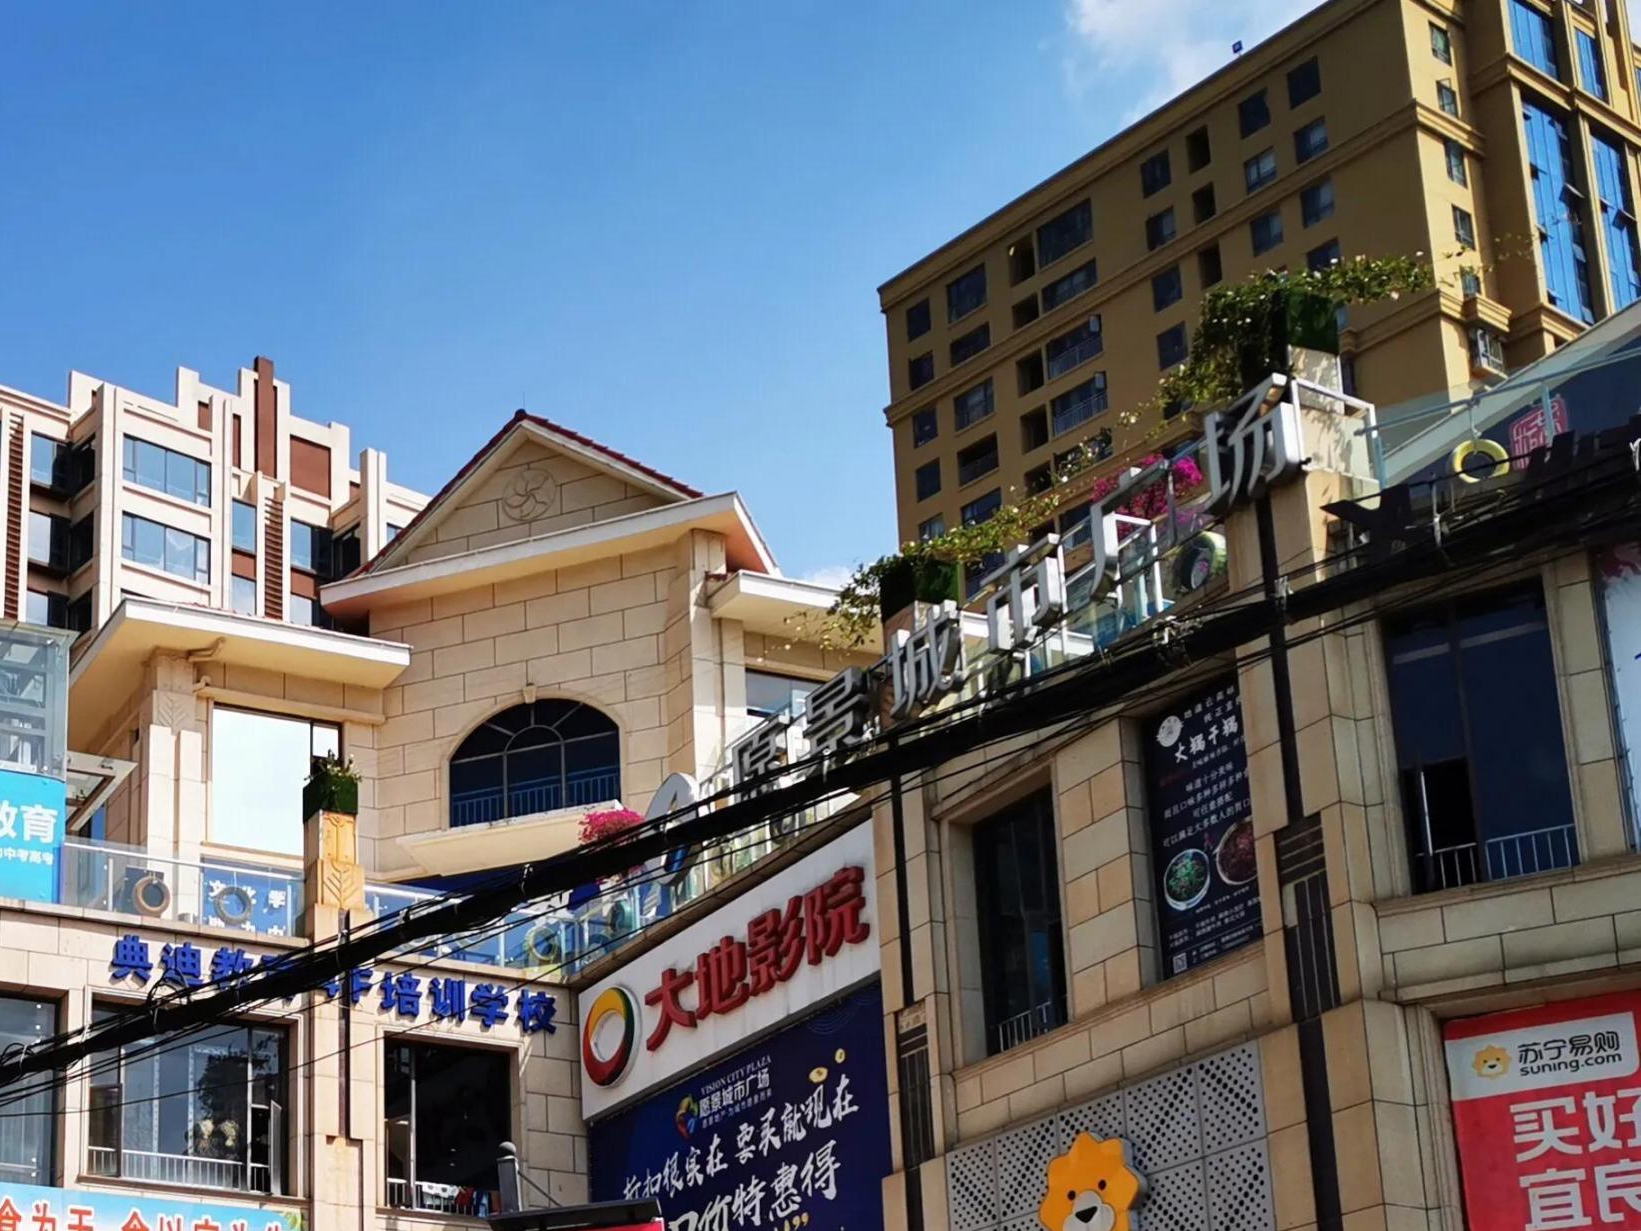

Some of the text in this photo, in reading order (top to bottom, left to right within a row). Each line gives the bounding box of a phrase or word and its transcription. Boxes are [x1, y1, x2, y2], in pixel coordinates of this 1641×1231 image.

[644, 866, 871, 1052] 大地影院
[1518, 1030, 1620, 1065] 苏宁易购
[1519, 1053, 1623, 1077] suning.com
[699, 1067, 770, 1118] 愿景城市广场
